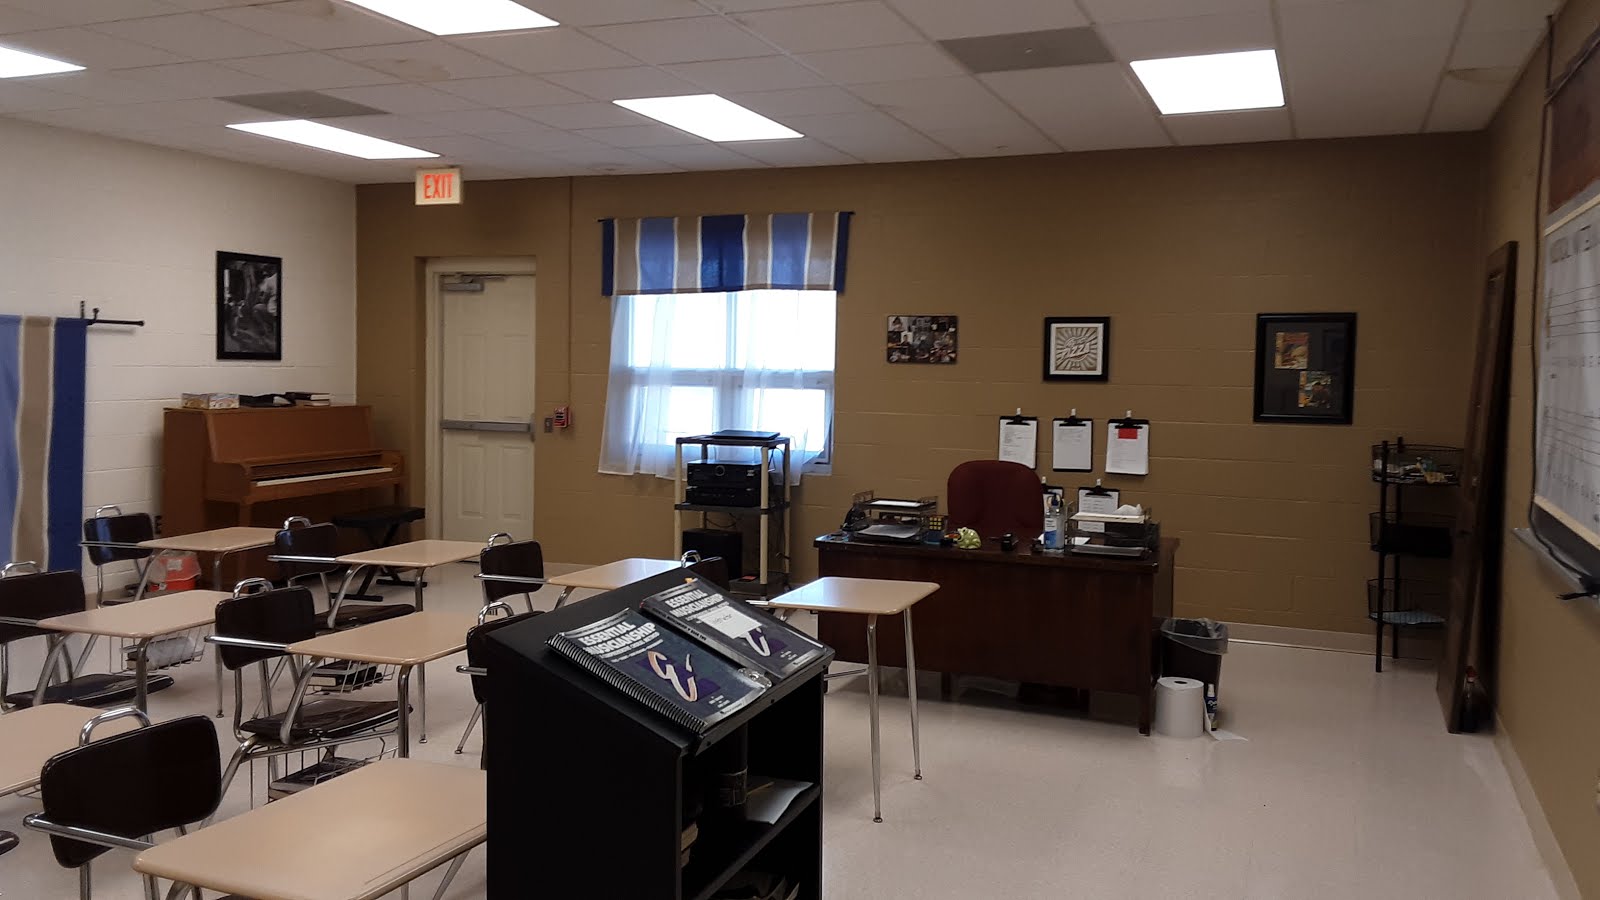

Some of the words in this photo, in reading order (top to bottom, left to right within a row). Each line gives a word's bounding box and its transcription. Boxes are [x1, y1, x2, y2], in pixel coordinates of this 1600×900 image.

[423, 173, 454, 199] EXIT
[665, 589, 708, 608] ESSENTIAL
[669, 593, 724, 617] MUSICIANSHIP
[578, 621, 636, 646] ESSENTIAL
[583, 622, 656, 655] MUSICIANSHIP
